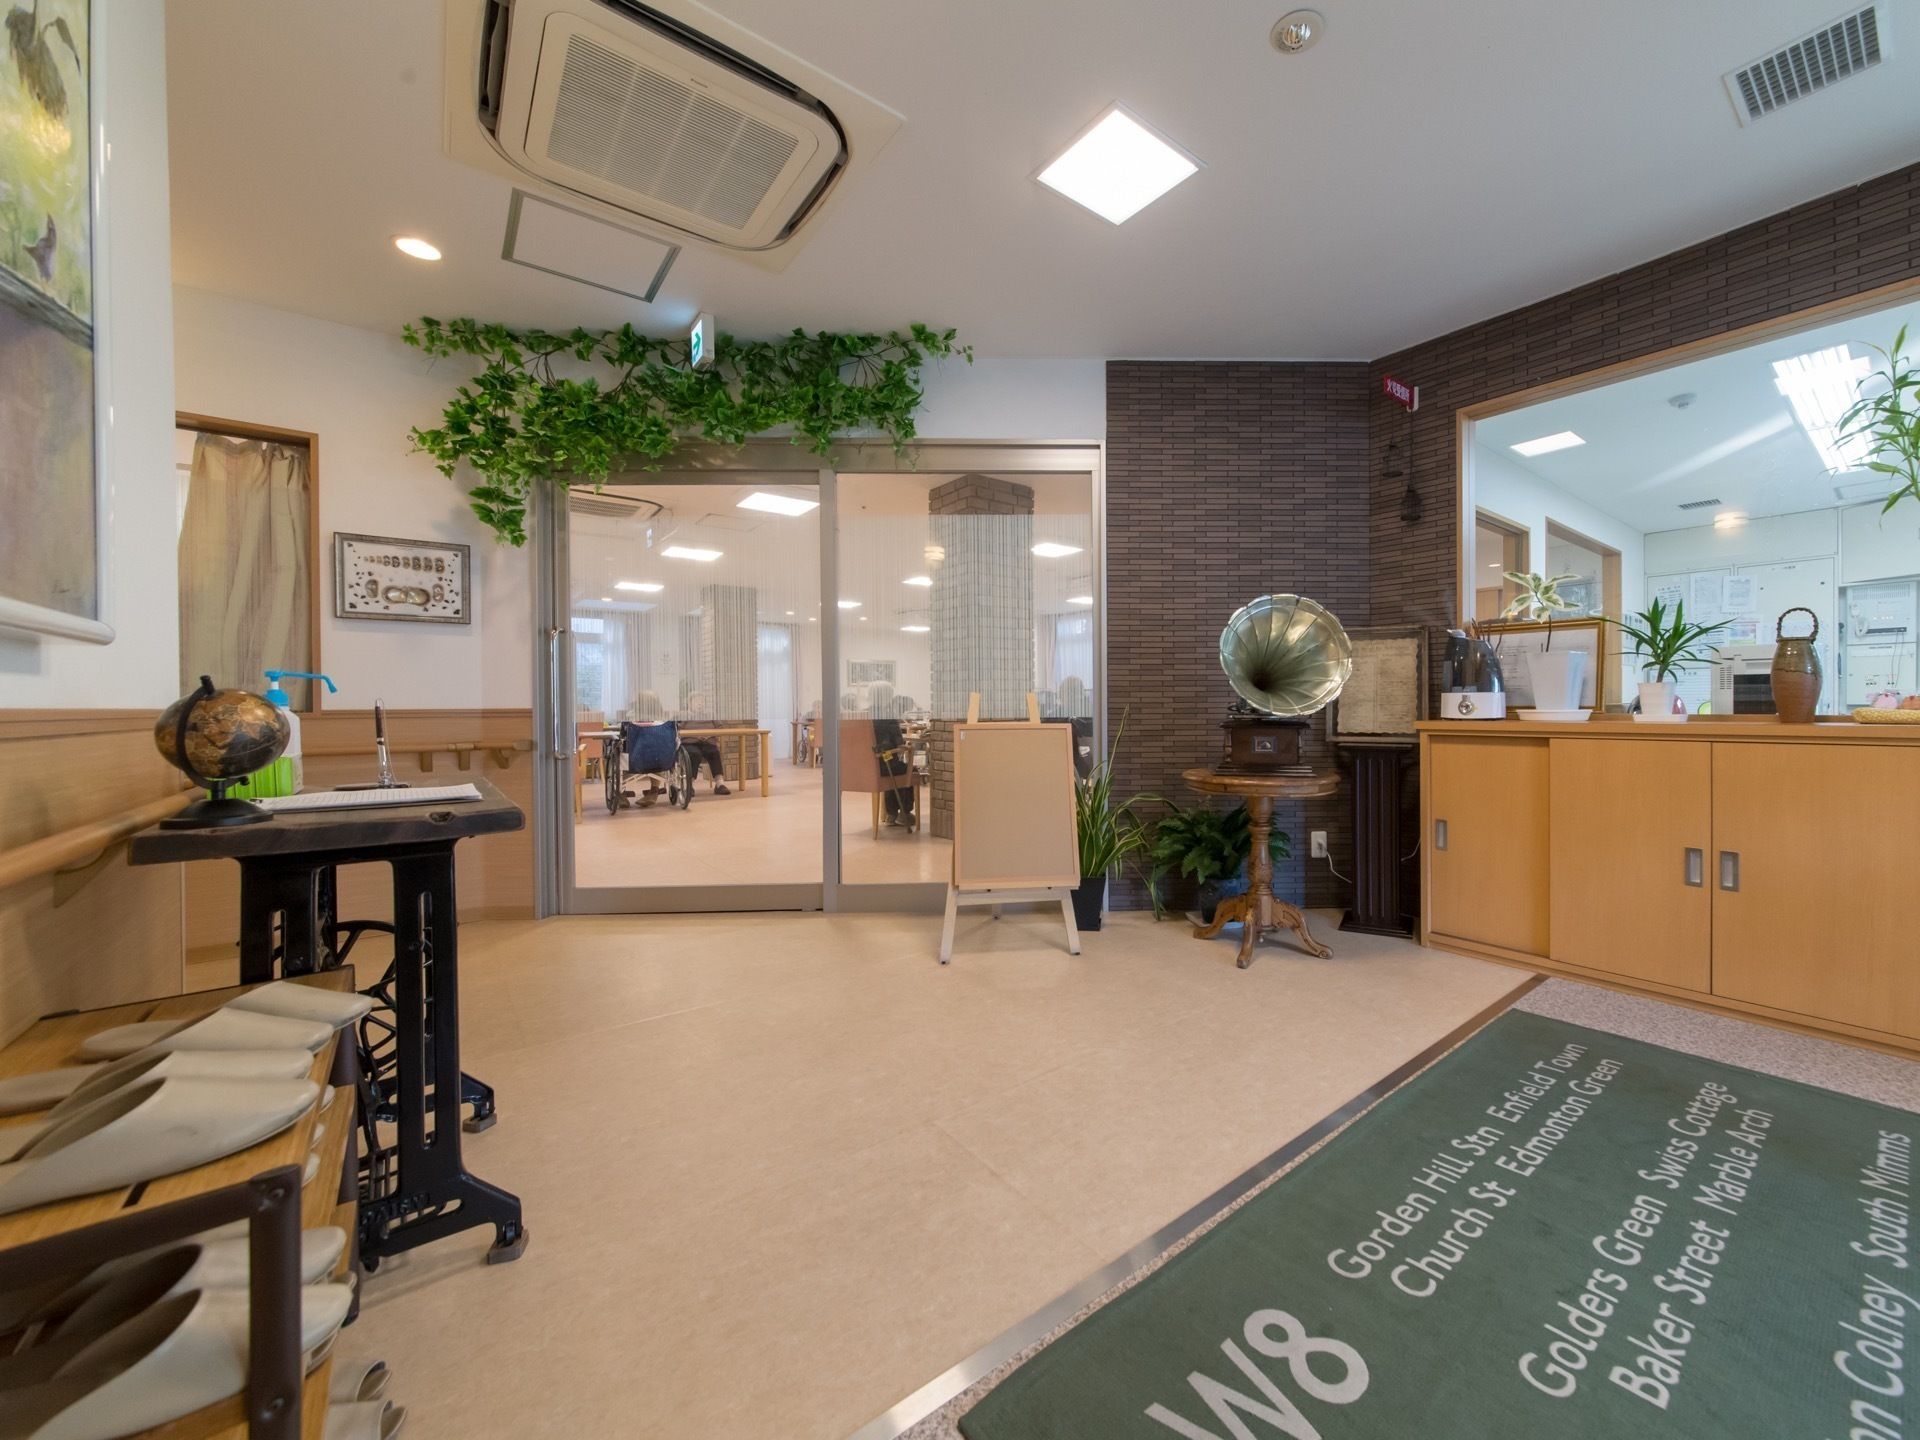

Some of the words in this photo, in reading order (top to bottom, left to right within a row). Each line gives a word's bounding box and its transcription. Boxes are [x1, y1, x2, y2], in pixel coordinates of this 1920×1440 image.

[1666, 1081, 1739, 1137] Cottage
[1725, 1108, 1776, 1150] Arch
[1327, 1191, 1437, 1280] Gorden
[1411, 1152, 1475, 1194] Hill
[1450, 1125, 1505, 1158] Stn
[1486, 1071, 1557, 1123] Enfield
[1533, 1043, 1589, 1085] Town
[1391, 1205, 1496, 1298] Church
[1467, 1180, 1518, 1208] St
[1495, 1094, 1593, 1178] Edmonton
[1568, 1057, 1625, 1096] Green
[1637, 1137, 1698, 1190] Swiss
[1693, 1146, 1759, 1215] Marble
[1859, 1130, 1911, 1198] Mimms
[1593, 1194, 1668, 1266] Green
[1653, 1220, 1728, 1306] Street
[1849, 1197, 1910, 1269] South
[1518, 1267, 1629, 1399] Golders
[1609, 1302, 1696, 1409] Baker
[1833, 1273, 1920, 1397] Colney
